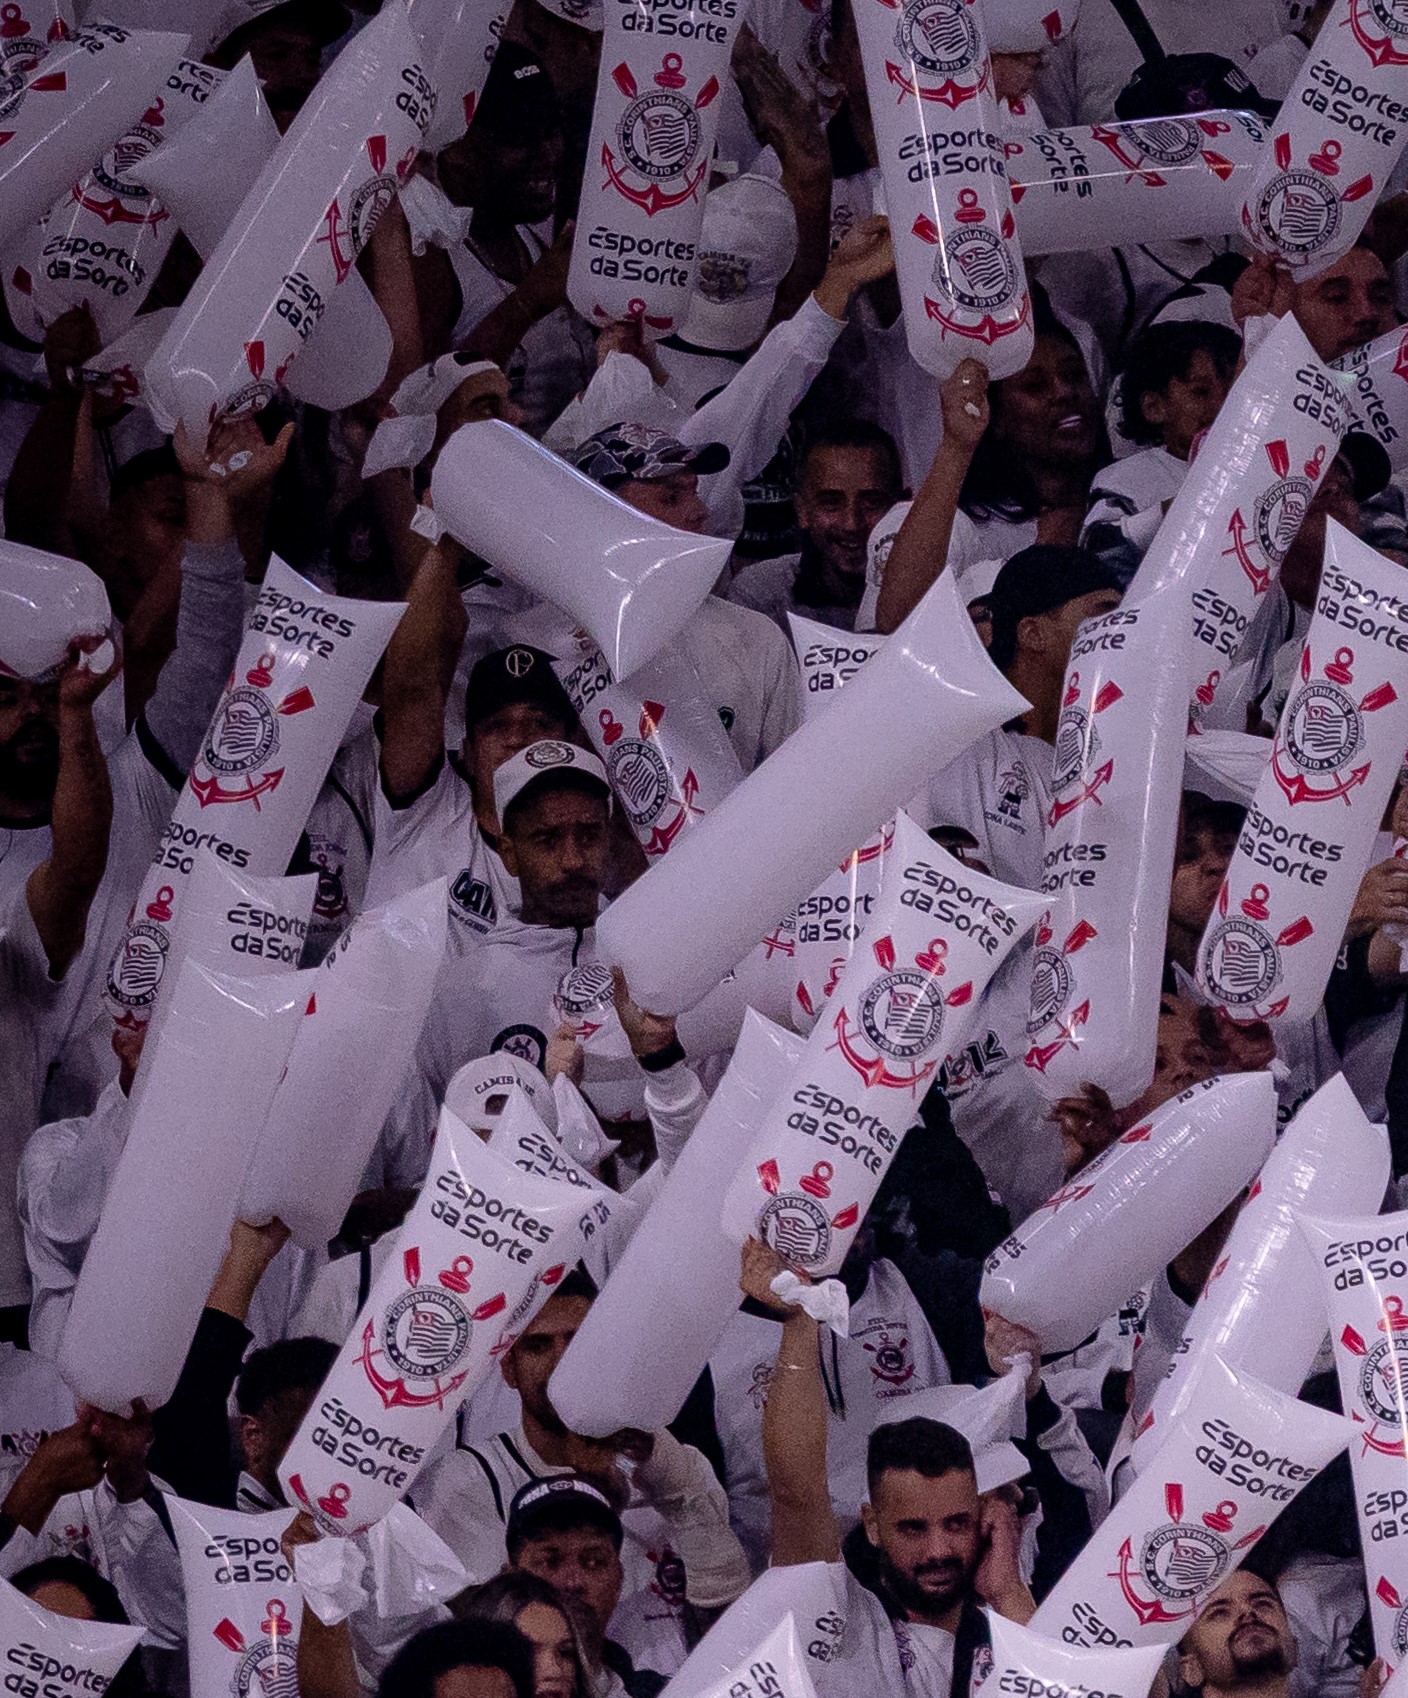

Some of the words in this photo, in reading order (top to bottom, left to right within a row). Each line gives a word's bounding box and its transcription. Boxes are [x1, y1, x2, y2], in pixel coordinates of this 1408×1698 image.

[589, 226, 695, 261] Esportes
[904, 862, 1017, 935] Esportes
[794, 1084, 897, 1153] Esportes
[436, 1170, 554, 1243] Esportes
[321, 1398, 424, 1464] Esportes
[1202, 1419, 1317, 1481] Esportes
